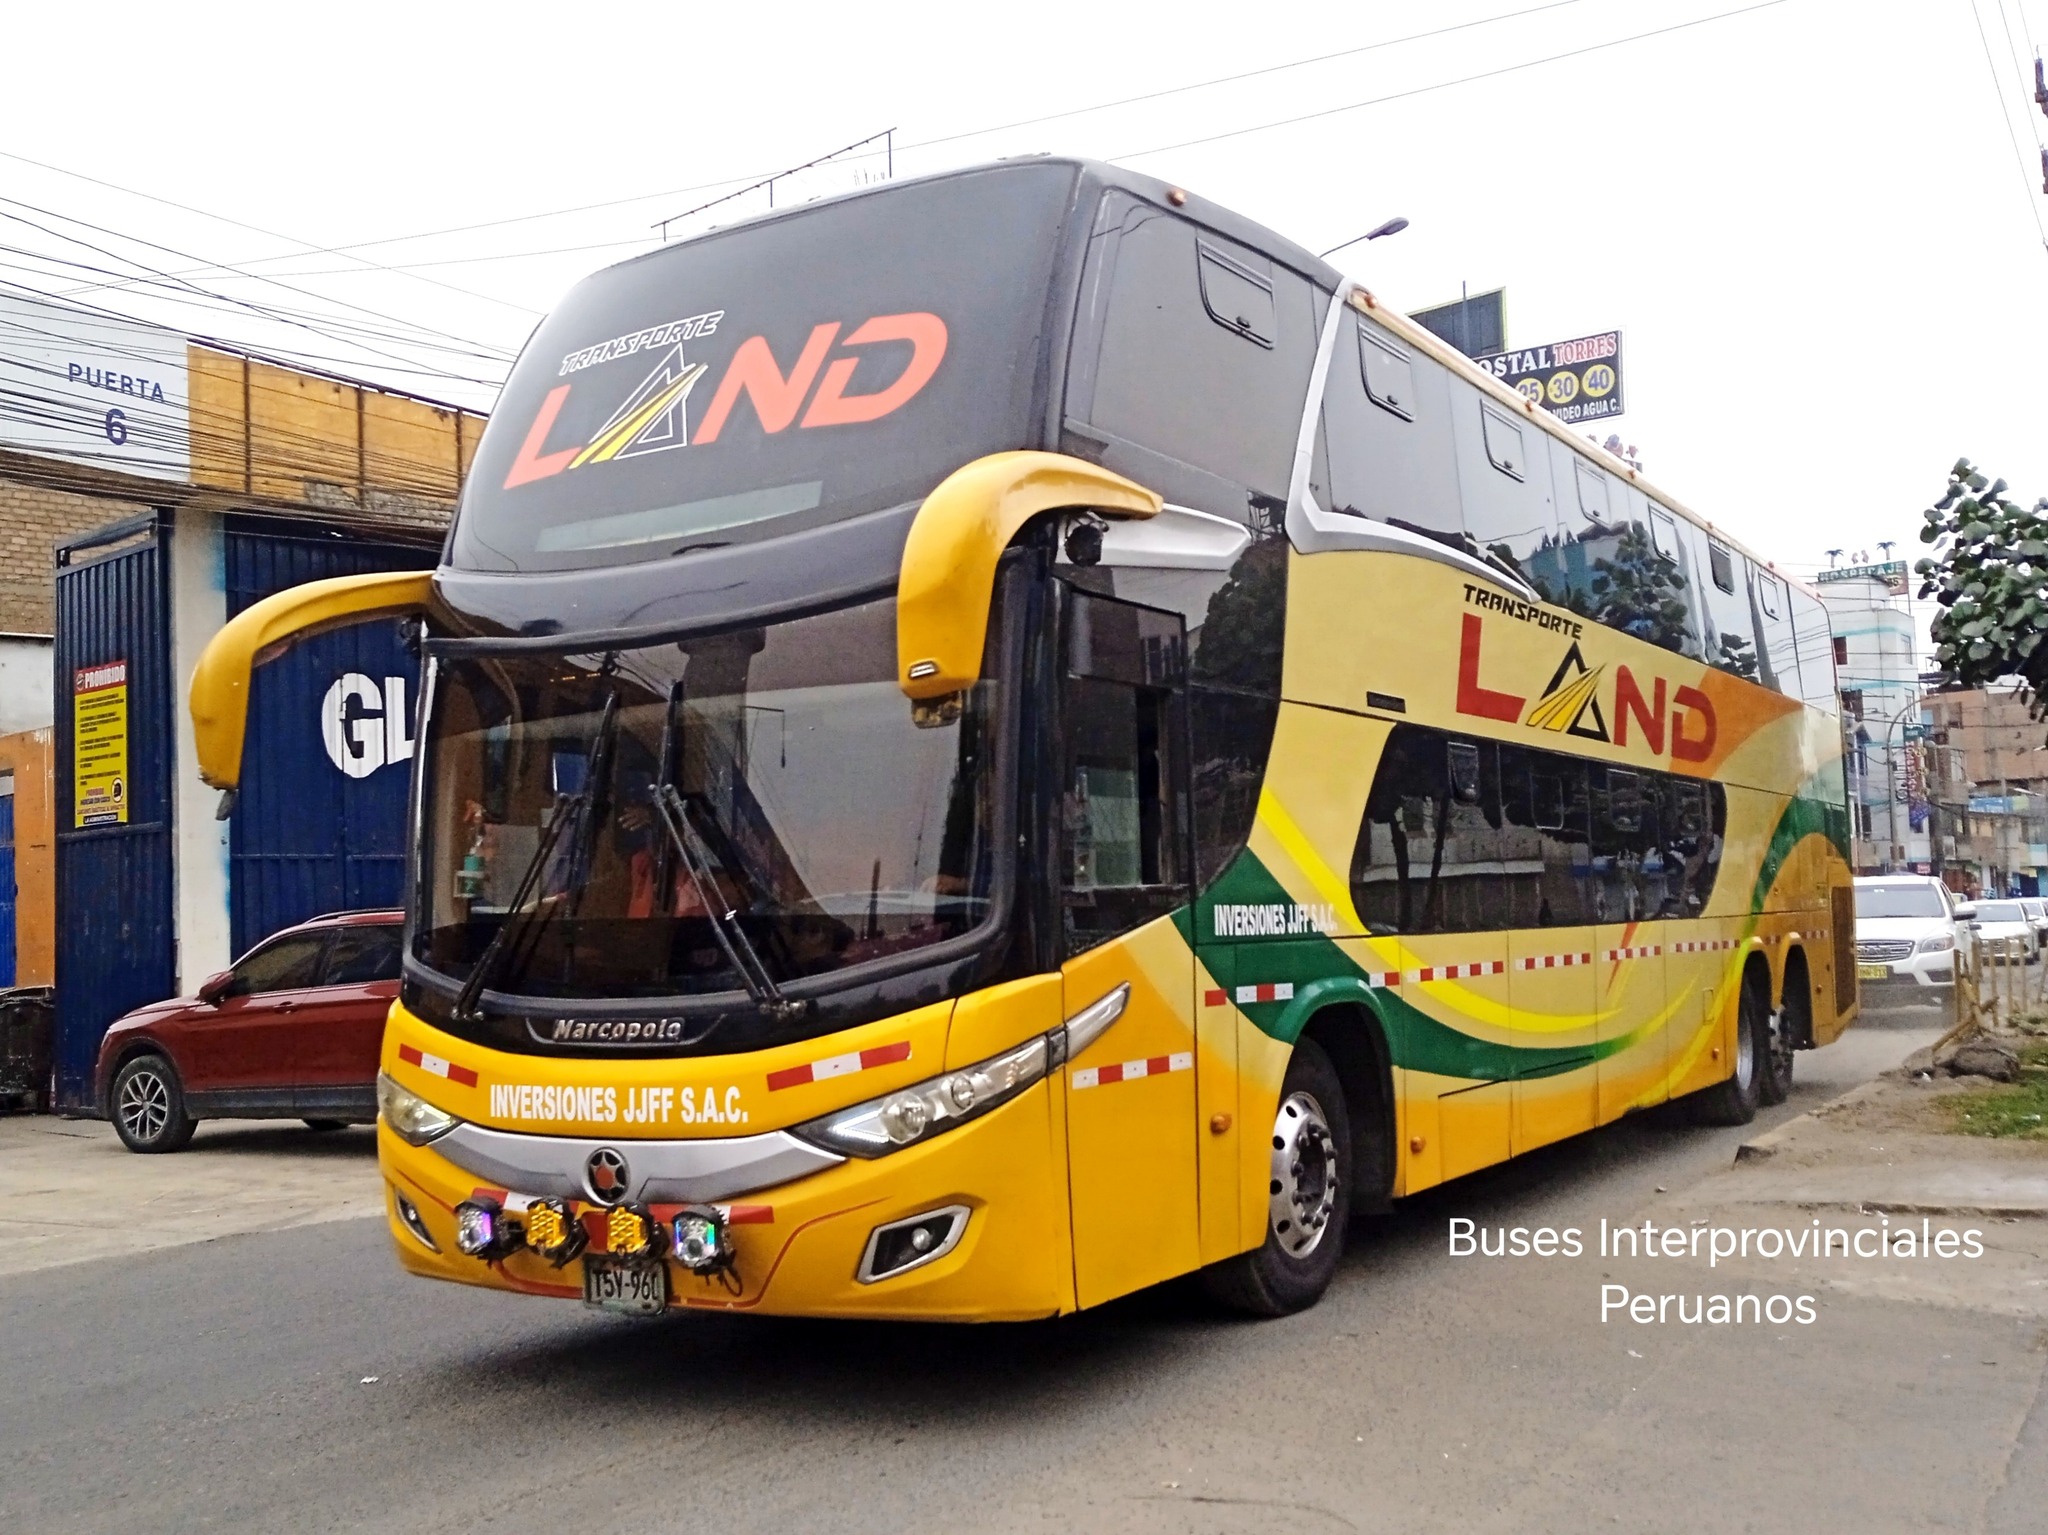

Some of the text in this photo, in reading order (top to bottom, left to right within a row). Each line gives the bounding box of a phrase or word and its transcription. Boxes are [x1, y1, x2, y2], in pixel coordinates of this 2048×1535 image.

[558, 310, 724, 375] TRANSPORTE
[1478, 331, 1618, 377] OSTAL TORRES
[68, 362, 165, 403] PUERTA
[503, 312, 948, 489] LAND
[1553, 376, 1575, 398] 30
[1587, 368, 1610, 391] 40
[105, 408, 127, 446] 6
[1553, 404, 1582, 420] VIDEO
[1583, 399, 1610, 417] AGUA
[1463, 583, 1583, 640] TRANSPORTE
[84, 664, 126, 689] PROHIBIDO
[1456, 612, 1717, 763] LAND
[321, 672, 420, 778] GL
[1213, 904, 1286, 936] INVERSIONES
[1287, 904, 1310, 934] JJFF
[552, 1019, 682, 1041] Marcopolo
[490, 1084, 748, 1123] INVERSIONES JJFF S.A.C.
